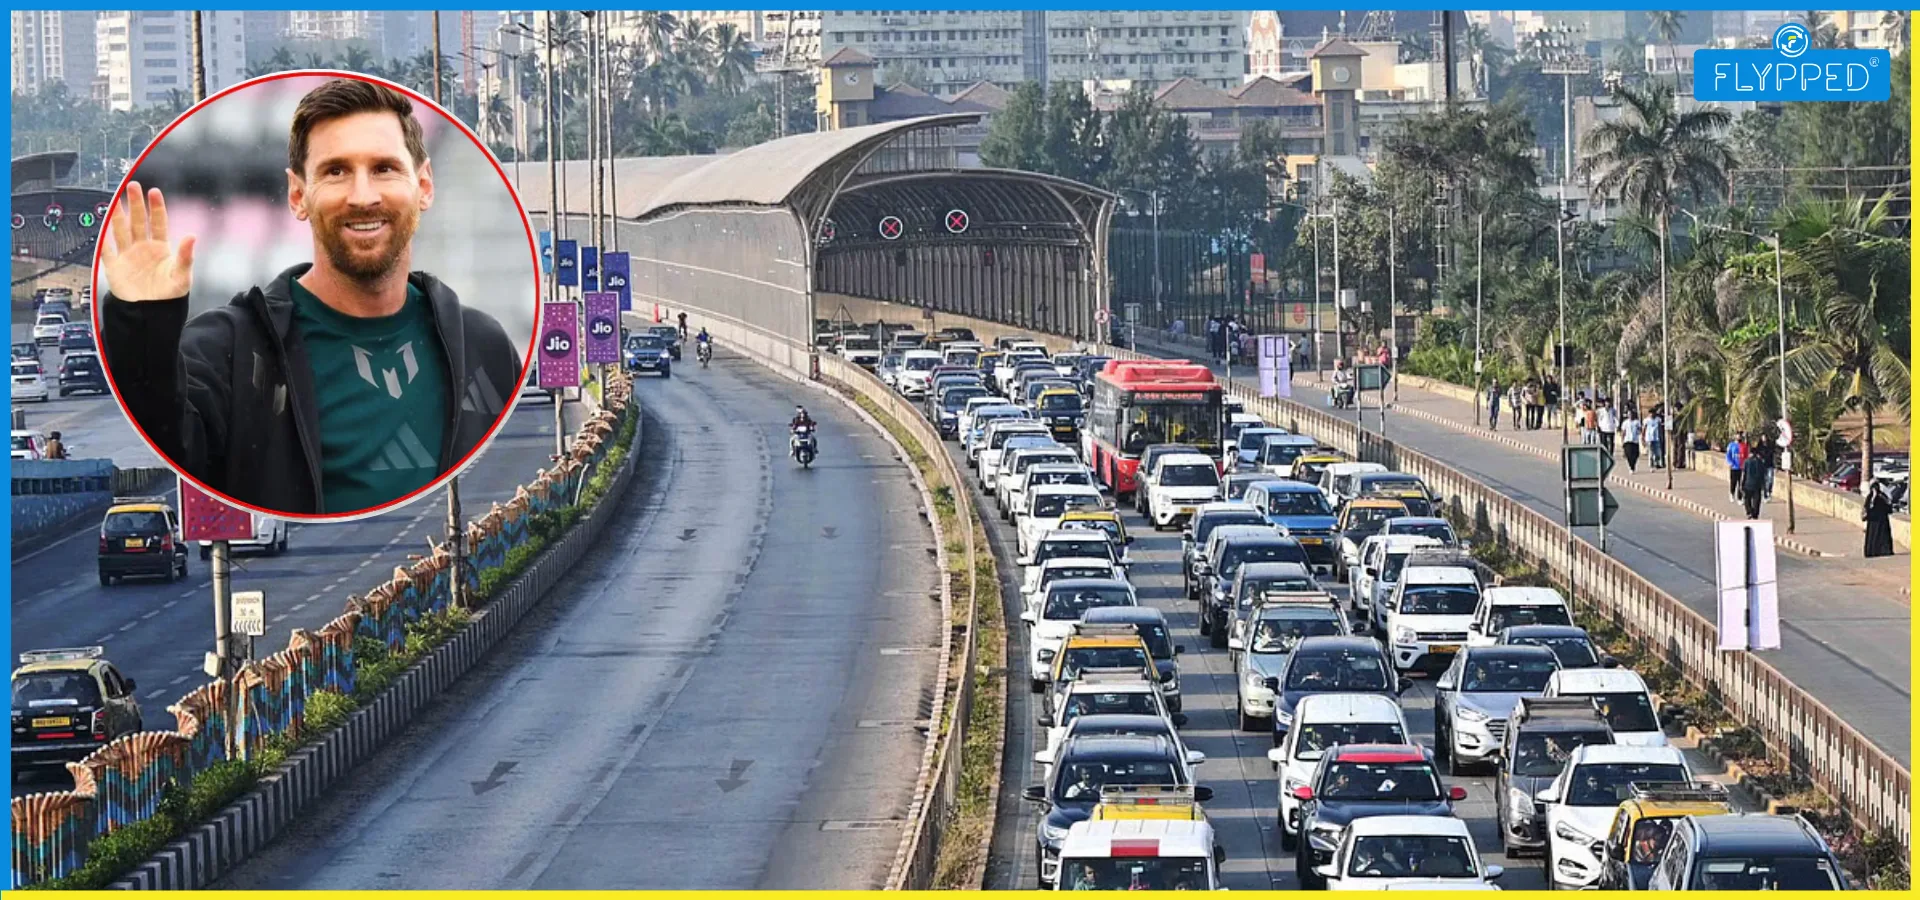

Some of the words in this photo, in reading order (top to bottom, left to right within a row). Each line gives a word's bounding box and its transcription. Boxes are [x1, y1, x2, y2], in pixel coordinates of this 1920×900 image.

[560, 257, 573, 267] Jio
[608, 275, 625, 287] Jio
[591, 322, 613, 334] Jio
[545, 336, 570, 351] Jio
